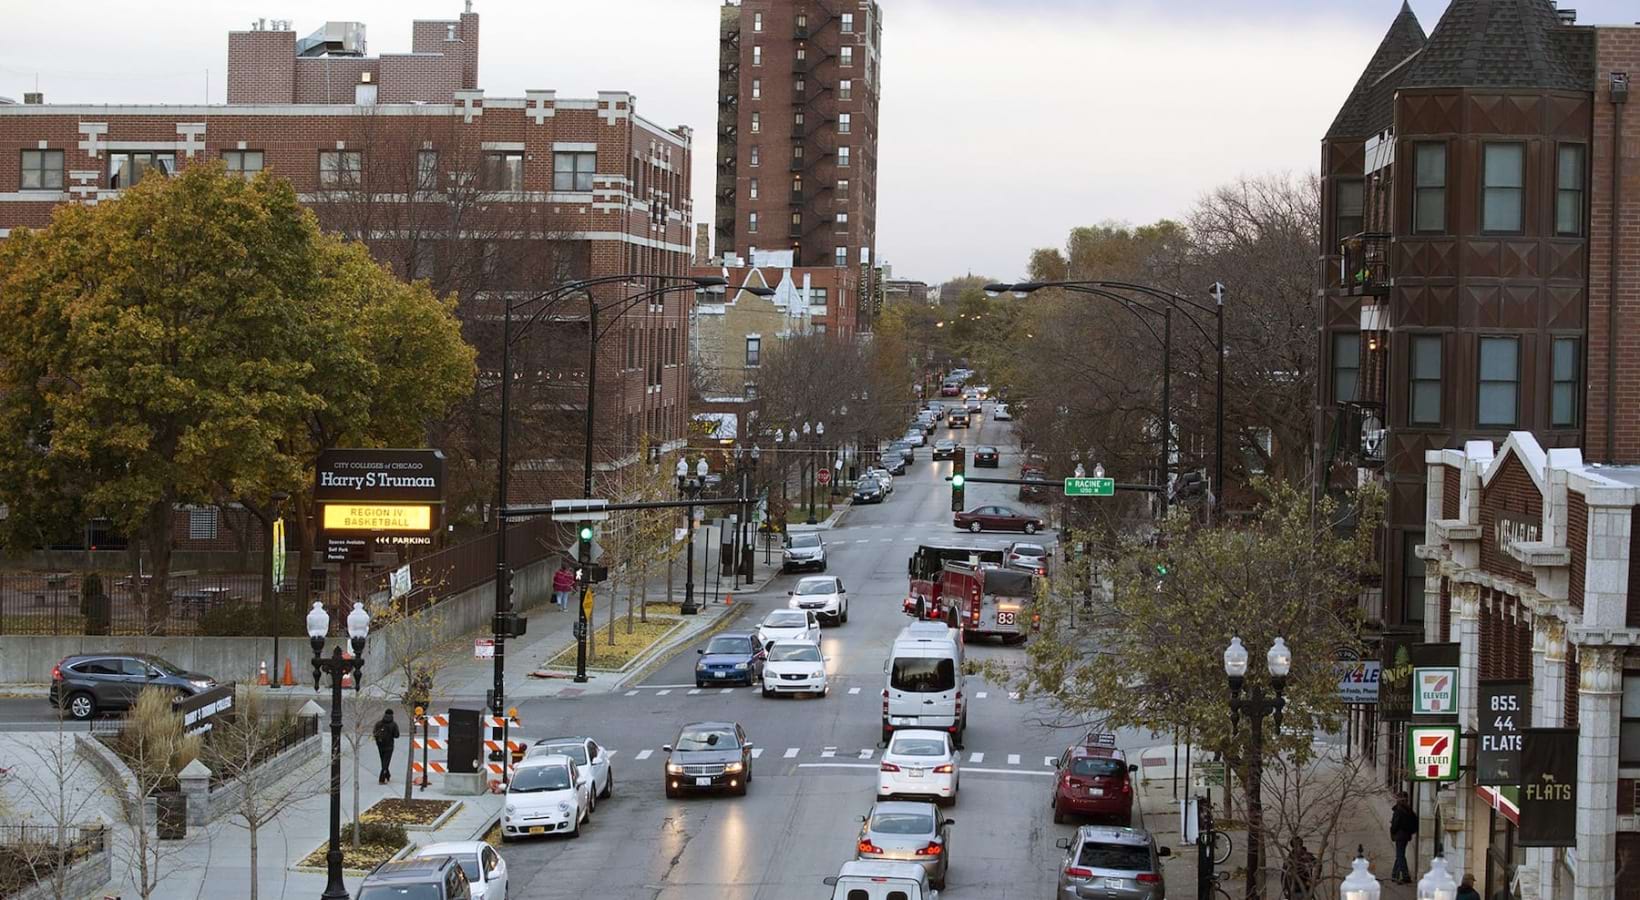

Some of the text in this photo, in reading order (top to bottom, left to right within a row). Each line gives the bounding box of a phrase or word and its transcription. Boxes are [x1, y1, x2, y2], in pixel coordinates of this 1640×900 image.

[350, 462, 384, 470] COLLEGES
[321, 472, 435, 490] Harry S Truman
[1075, 480, 1101, 488] RACINE
[350, 508, 404, 516] REGION IV
[344, 517, 409, 526] BASKETBALL
[392, 536, 431, 544] PARKING
[998, 613, 1014, 625] 83
[1424, 675, 1448, 691] 7
[1491, 696, 1520, 711] 855.
[1494, 716, 1516, 731] 44.
[1420, 736, 1448, 755] 7
[1483, 735, 1522, 751] FLATS
[1526, 784, 1571, 800] FLATS
